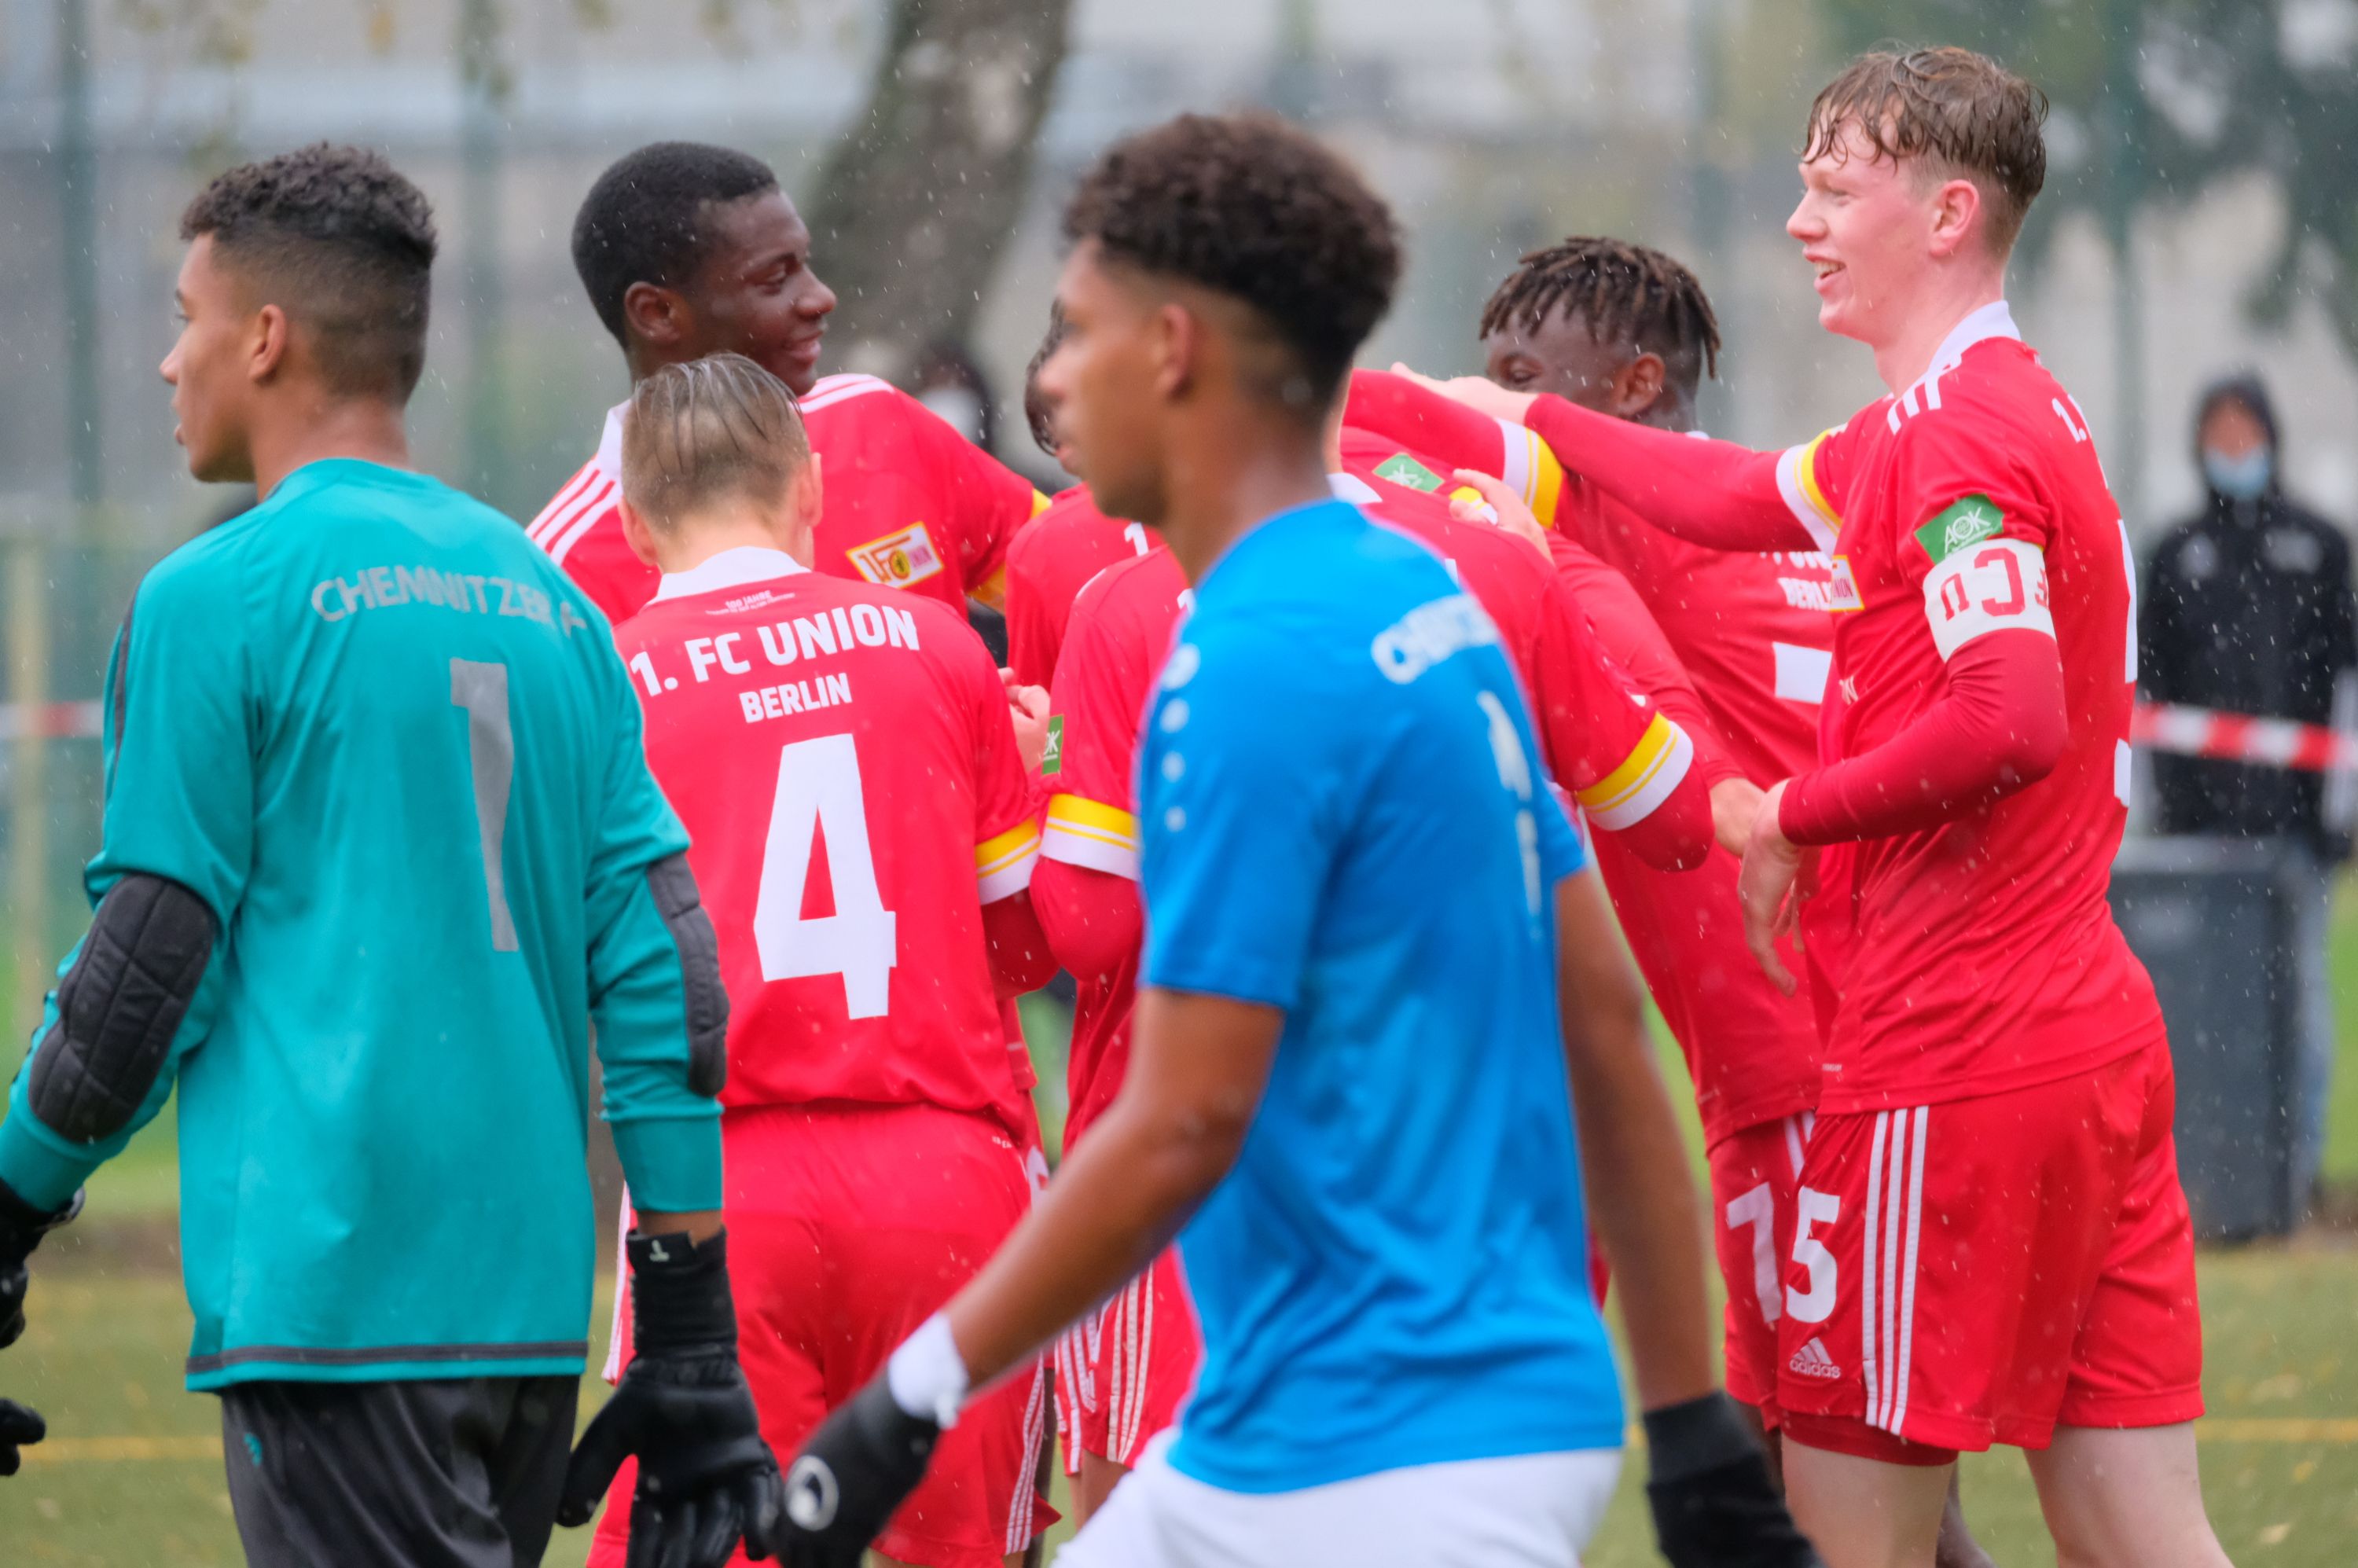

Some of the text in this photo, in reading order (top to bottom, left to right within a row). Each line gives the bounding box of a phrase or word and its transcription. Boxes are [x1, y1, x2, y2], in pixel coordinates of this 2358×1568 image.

[1945, 507, 1991, 554] AOK
[630, 652, 678, 696] 1.
[685, 633, 751, 682] FC
[758, 604, 920, 666] UNION
[740, 673, 852, 723] BERLIN
[450, 657, 519, 952] 1
[753, 733, 896, 1019] 4
[1786, 1185, 1840, 1324] 5
[1789, 1358, 1841, 1379] adidas
